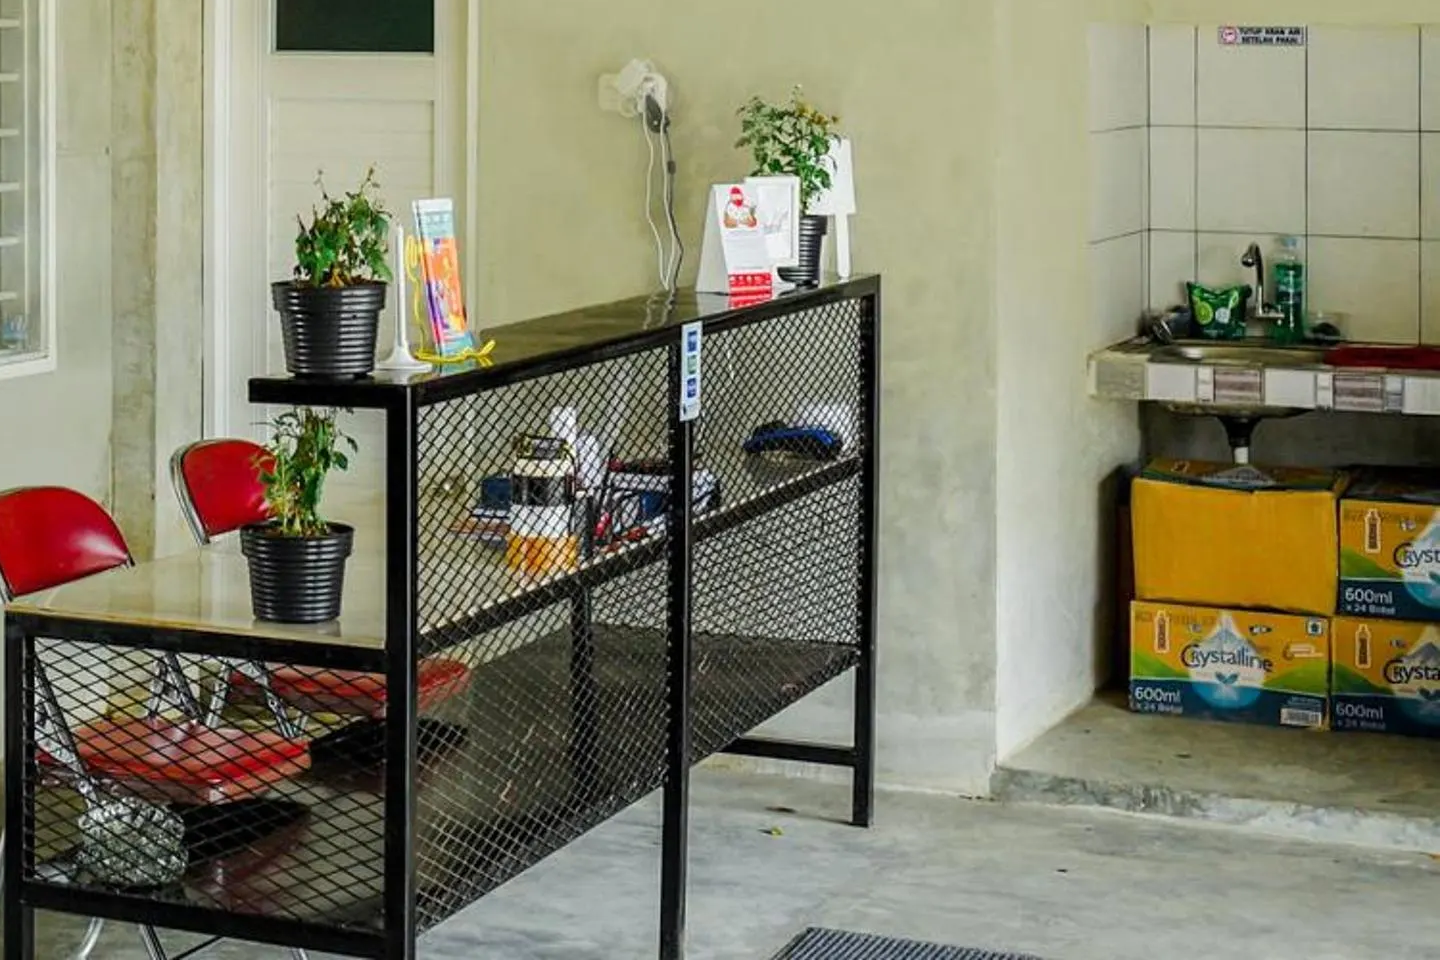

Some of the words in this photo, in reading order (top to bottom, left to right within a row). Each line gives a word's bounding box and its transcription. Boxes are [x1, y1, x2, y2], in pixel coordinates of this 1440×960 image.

[1345, 587, 1393, 604] 600ml
[1134, 686, 1181, 704] 600ml
[1336, 703, 1384, 720] 600ml
